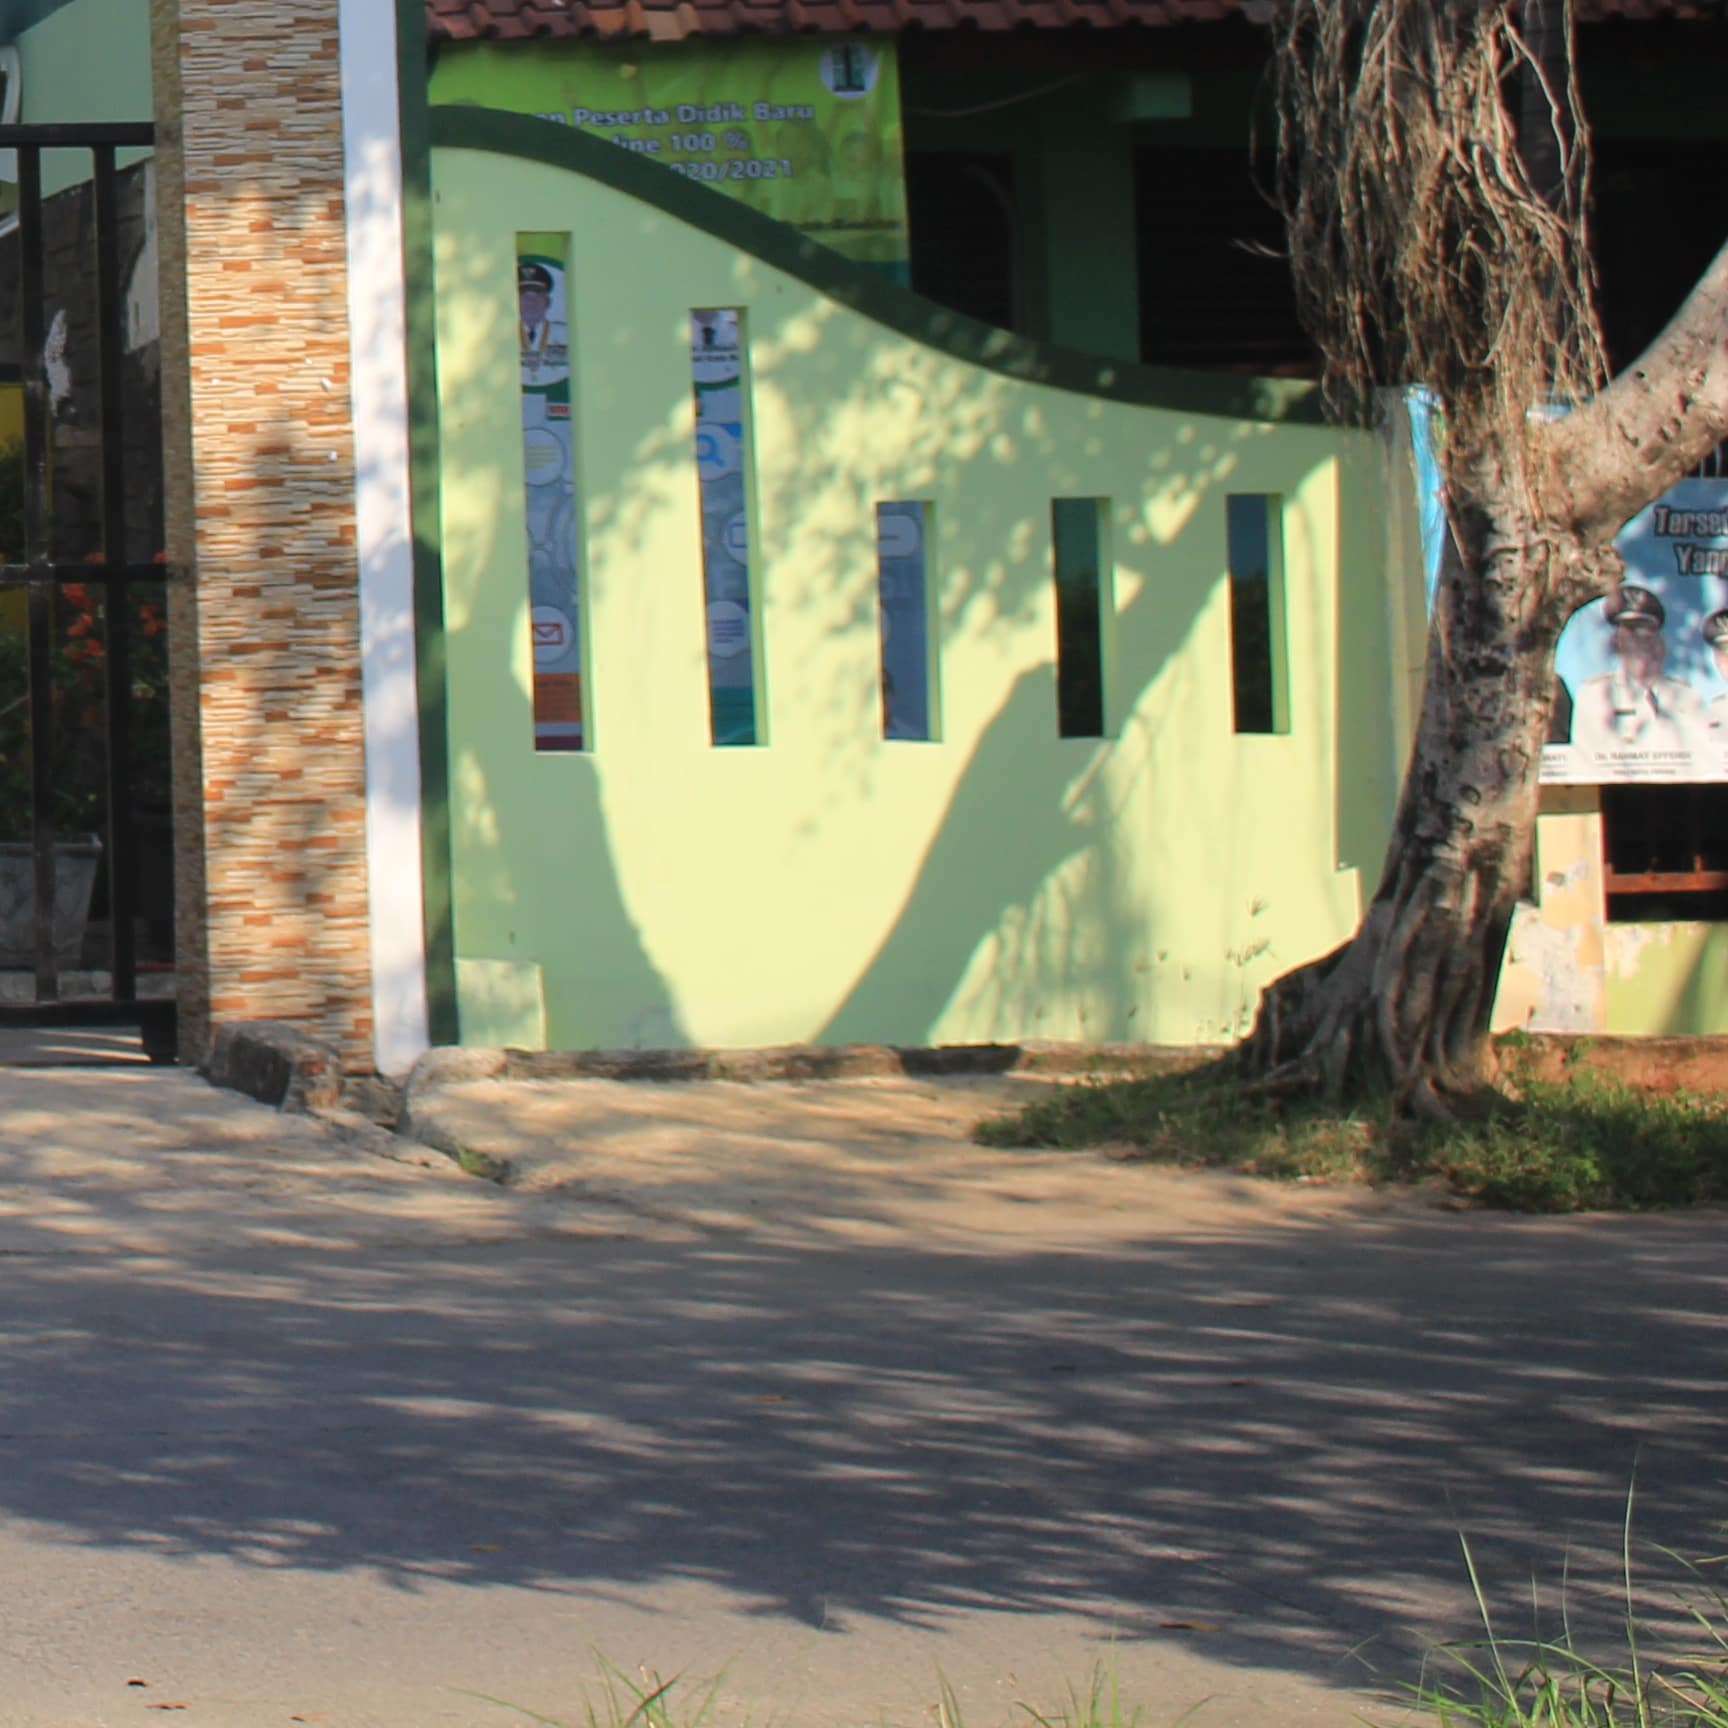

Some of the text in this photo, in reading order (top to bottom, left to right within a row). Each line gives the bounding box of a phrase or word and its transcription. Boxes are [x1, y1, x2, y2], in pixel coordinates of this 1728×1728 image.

[574, 107, 669, 127] Peserta
[677, 103, 744, 124] Didik
[753, 101, 814, 121] Baru
[670, 134, 715, 152] 100
